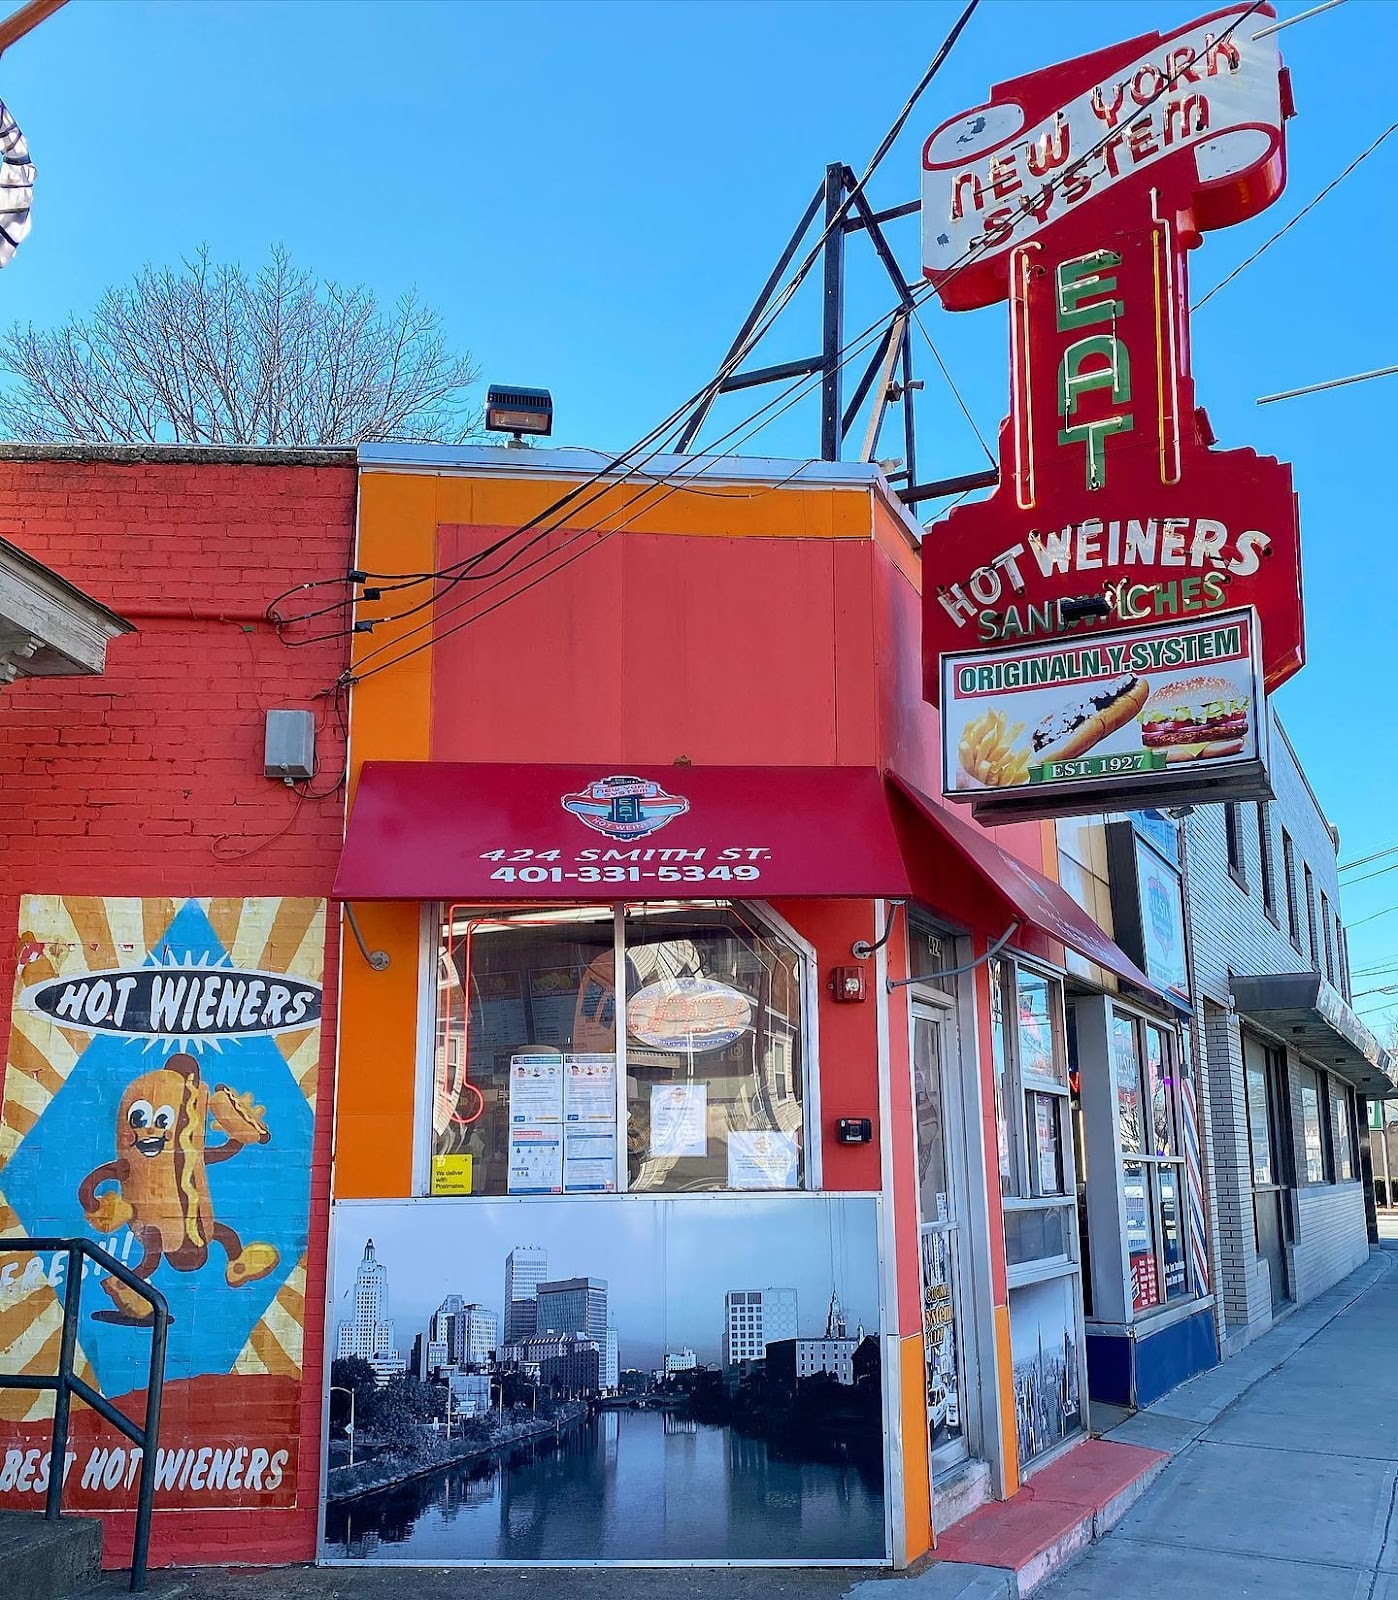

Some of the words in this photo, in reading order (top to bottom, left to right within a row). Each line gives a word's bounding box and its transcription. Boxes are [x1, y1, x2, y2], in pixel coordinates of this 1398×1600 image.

[951, 112, 1071, 221] NEW
[1091, 31, 1241, 128] YORK
[972, 94, 1209, 247] SYSTEM
[1055, 249, 1133, 491] EAT
[938, 543, 1025, 628] HOT
[1028, 518, 1272, 577] WEINERS
[1051, 761, 1091, 778] EST.
[1100, 755, 1144, 773] 1927
[592, 818, 612, 828] HOT
[619, 798, 632, 821] EAT
[479, 848, 561, 861] 424
[575, 848, 705, 861] SMITH
[717, 848, 772, 860] ST.
[489, 865, 760, 882] 401-331-5349
[57, 977, 137, 1027] HOT
[150, 976, 314, 1030] WIENERS
[630, 998, 744, 1032] OPEN
[81, 1447, 143, 1490] HOT
[154, 1447, 288, 1491] WIENERS
